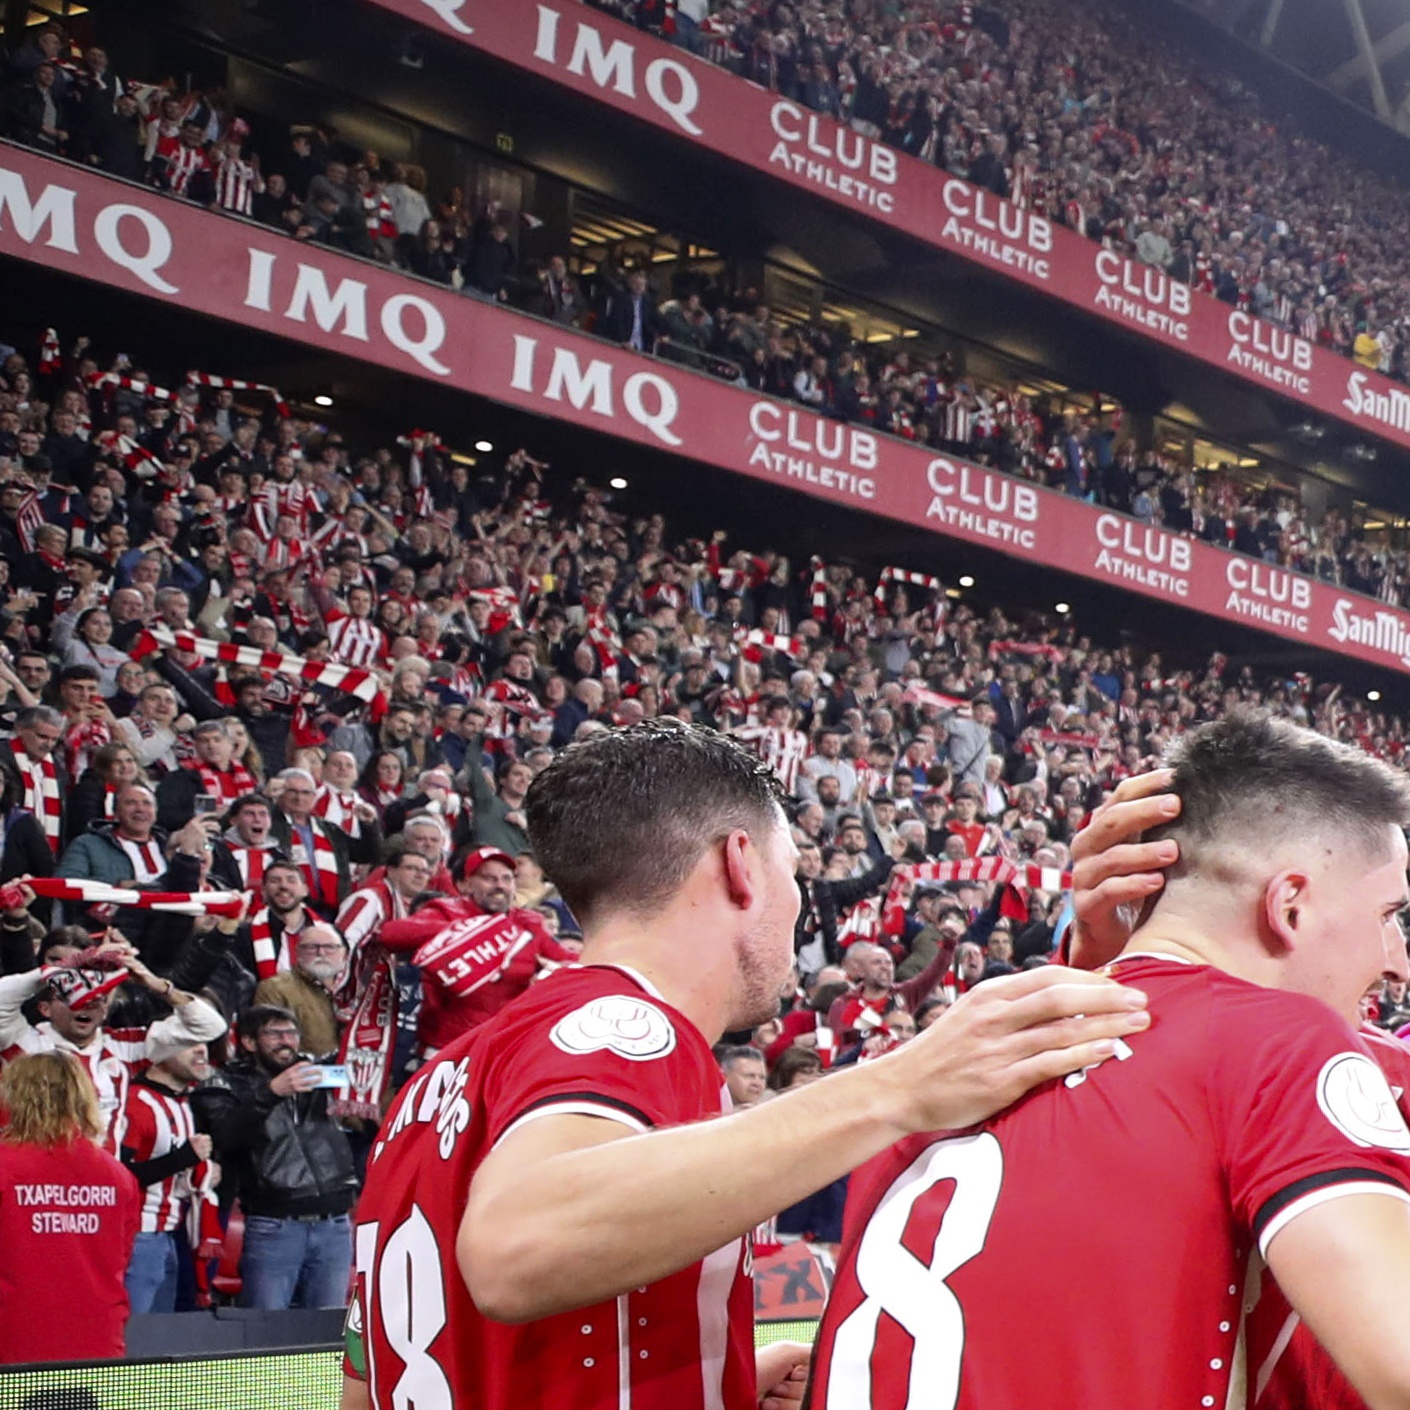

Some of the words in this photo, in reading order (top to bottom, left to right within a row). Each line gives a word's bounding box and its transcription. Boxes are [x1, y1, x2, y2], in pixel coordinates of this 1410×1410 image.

[533, 4, 702, 135] IMQ
[770, 101, 897, 184] CLUB
[769, 141, 894, 213] ATHLETIC
[942, 179, 1053, 251] CLUB
[941, 217, 1049, 279] ATHLETIC
[244, 247, 450, 375] IMQ
[1094, 251, 1191, 315] CLUB
[1094, 285, 1188, 340] ATHLETIC
[1227, 311, 1312, 370] CLUB
[1227, 344, 1311, 394] ATHLETIC
[511, 334, 681, 446] IMQ
[750, 402, 879, 470] CLUB
[749, 443, 876, 499] ATHLETIC
[926, 458, 1038, 521] CLUB
[926, 496, 1035, 548] ATHLETIC
[1096, 515, 1192, 571] CLUB
[1095, 550, 1189, 596] ATHLETIC
[1226, 559, 1312, 609] CLUB
[1226, 591, 1309, 632] ATHLETIC
[14, 1185, 117, 1207] TXAPELGORRI
[31, 1211, 100, 1234] STEWARD
